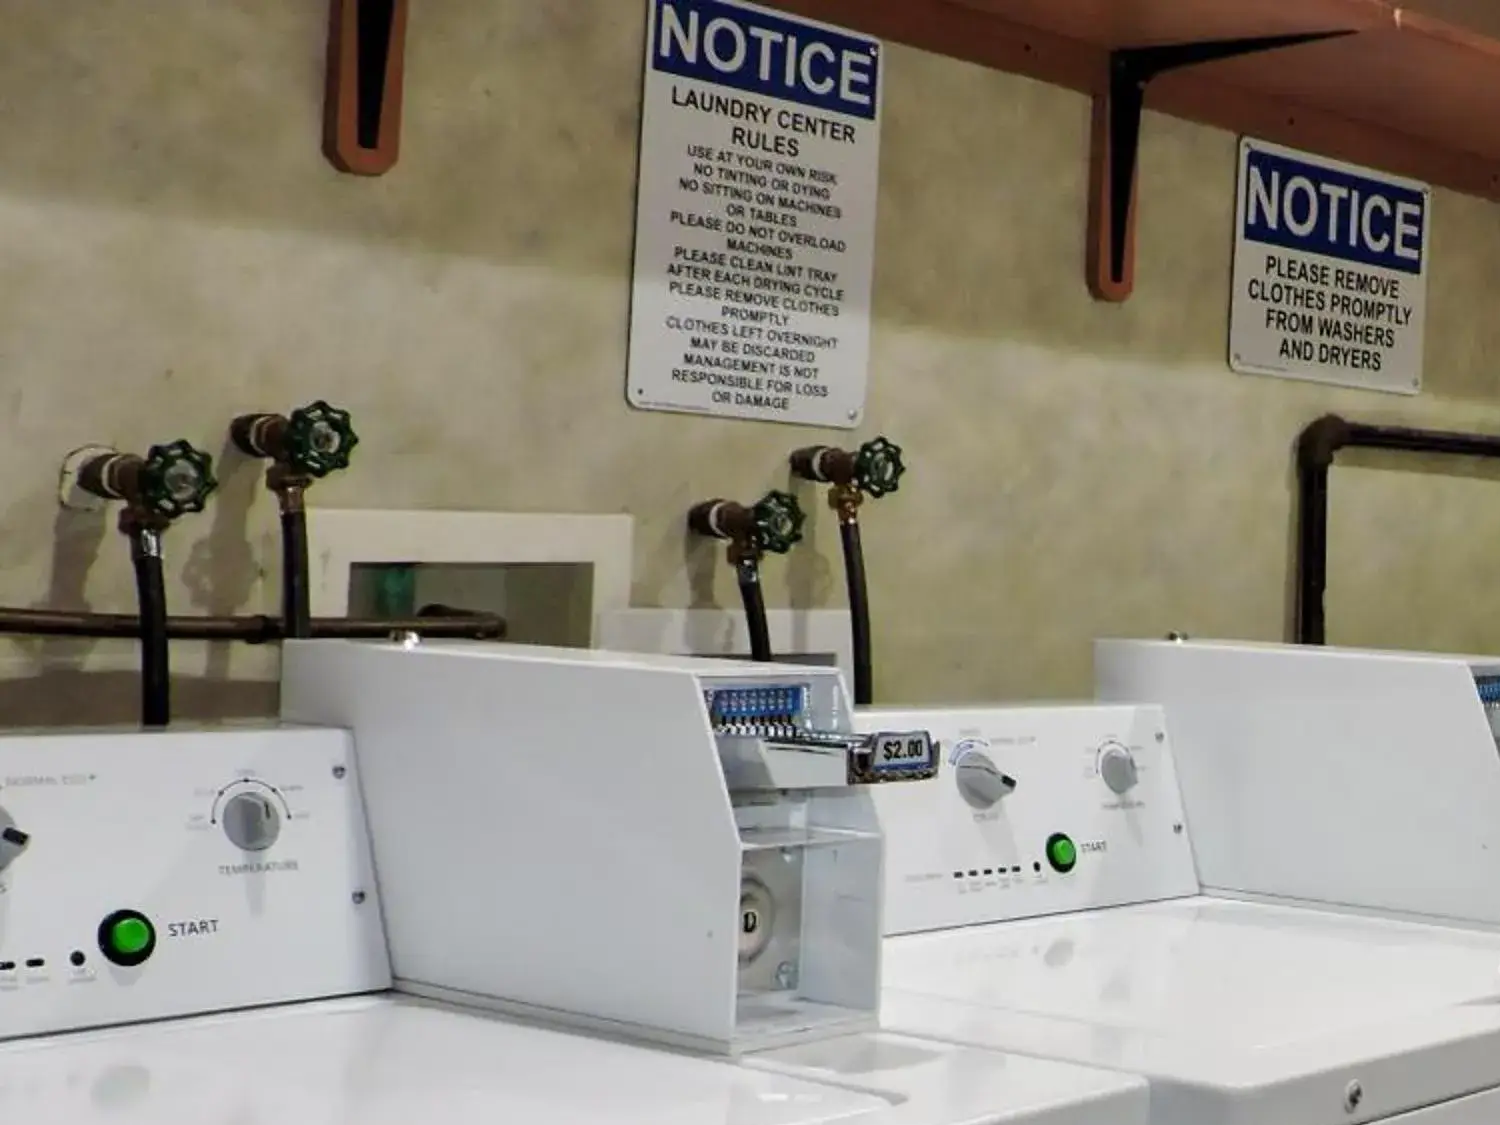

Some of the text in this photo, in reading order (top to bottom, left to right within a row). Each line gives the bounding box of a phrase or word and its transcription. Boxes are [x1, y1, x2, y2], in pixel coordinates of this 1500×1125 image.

[660, 4, 872, 104] NOTICE
[672, 85, 856, 144] LAUNDRY CENTER
[732, 126, 799, 157] RULES
[688, 144, 838, 185] USE AT YOUR OWN RISK
[694, 162, 830, 200] NO TINTING OR DYING
[679, 178, 842, 218] NO SITTING ON MACHINES
[726, 203, 797, 227] OR TABLES
[1248, 165, 1421, 260] NOTICE
[670, 211, 847, 252] PLEASE DO NOT OVERLOAD
[727, 238, 793, 259] MACHINES
[667, 263, 844, 301] AFTER EACH DRYING CYCLE
[674, 246, 838, 282] PLEASE CLEAN LINT TRAY
[1265, 255, 1400, 299] PLEASE REMOVE
[669, 281, 839, 317] PLEASE REMOVE CLOTHES
[721, 305, 790, 326] PROMPTLY
[1248, 279, 1412, 325] CLOTHES PROMPTLY
[666, 315, 838, 349] CLOTHES LEFT OVERNIGHT
[1266, 308, 1395, 348] FROM WASHERS
[684, 353, 819, 379] MANAGEMENT IS NOT
[690, 336, 815, 363] MAY BE DISCARDED
[1279, 338, 1382, 372] AND DRYERS
[671, 369, 828, 397] RESPONSIBLE FOR LOSS
[712, 391, 790, 410] OR DAMAGE
[883, 739, 924, 761] $2.00
[168, 918, 219, 937] START
